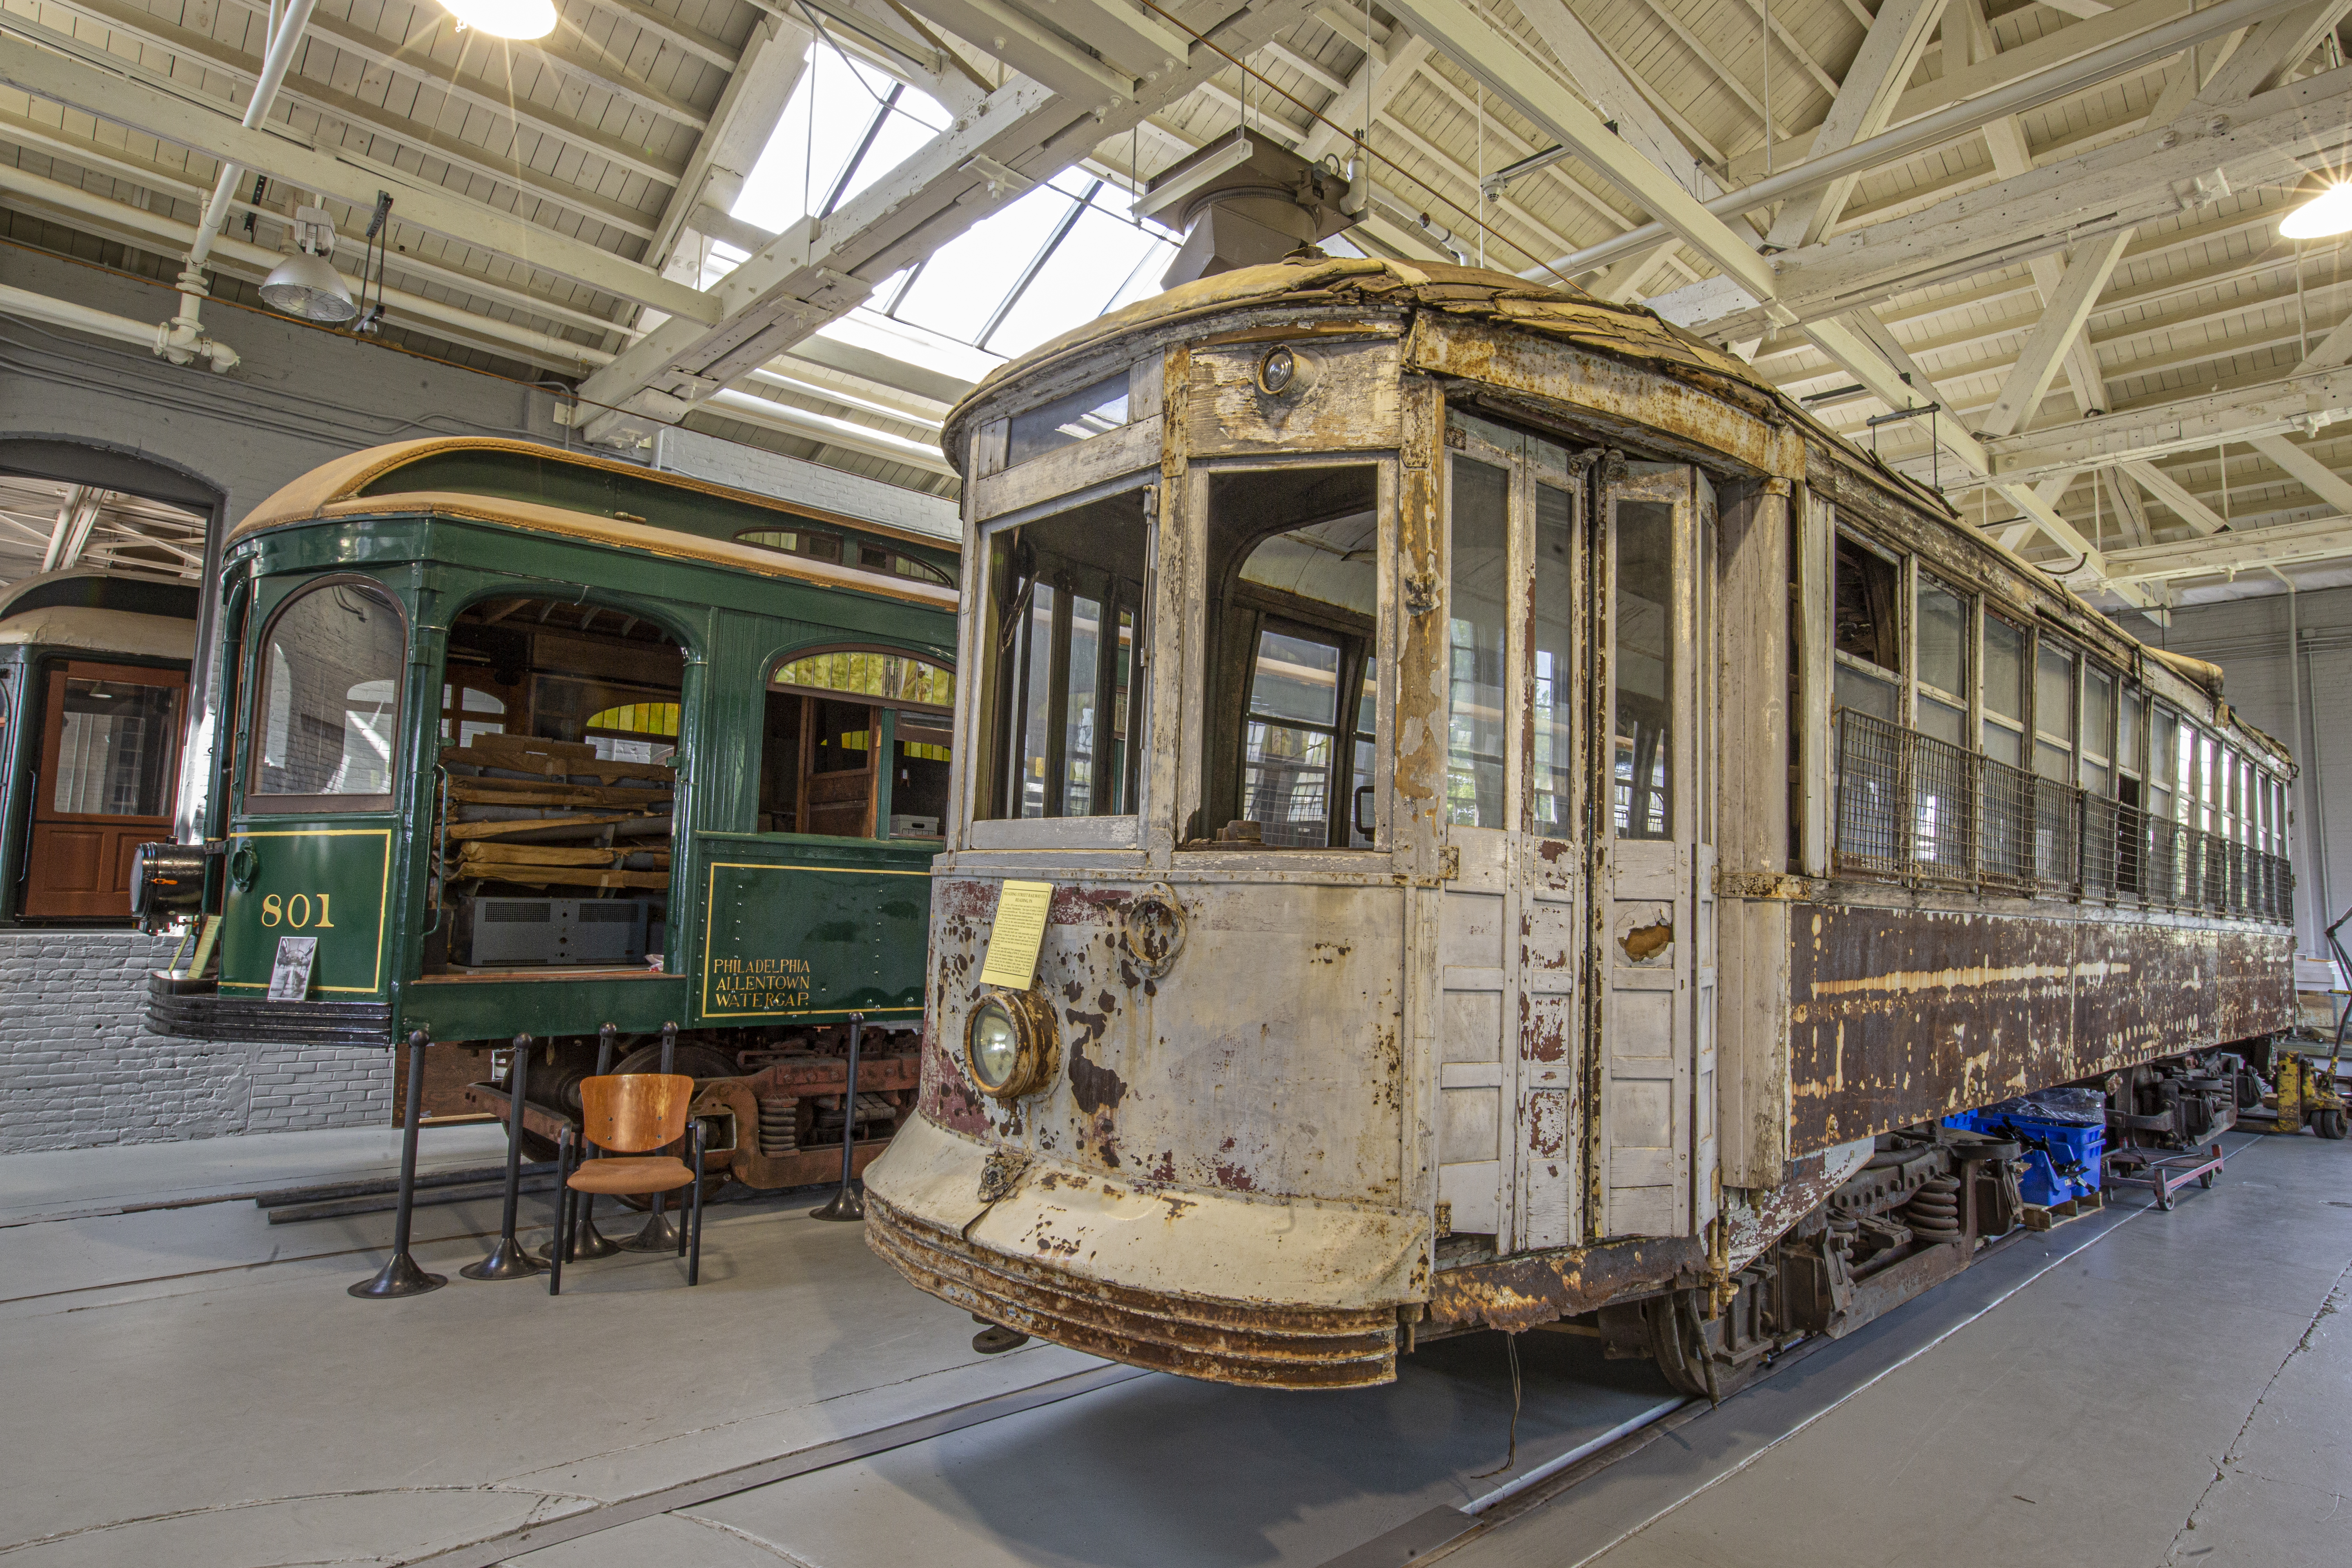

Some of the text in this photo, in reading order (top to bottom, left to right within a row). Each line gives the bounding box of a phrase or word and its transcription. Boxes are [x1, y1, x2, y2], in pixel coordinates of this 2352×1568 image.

[261, 893, 334, 928] 801
[714, 959, 810, 974] PHILADELPHIA
[716, 976, 809, 991] ALLENTOWN
